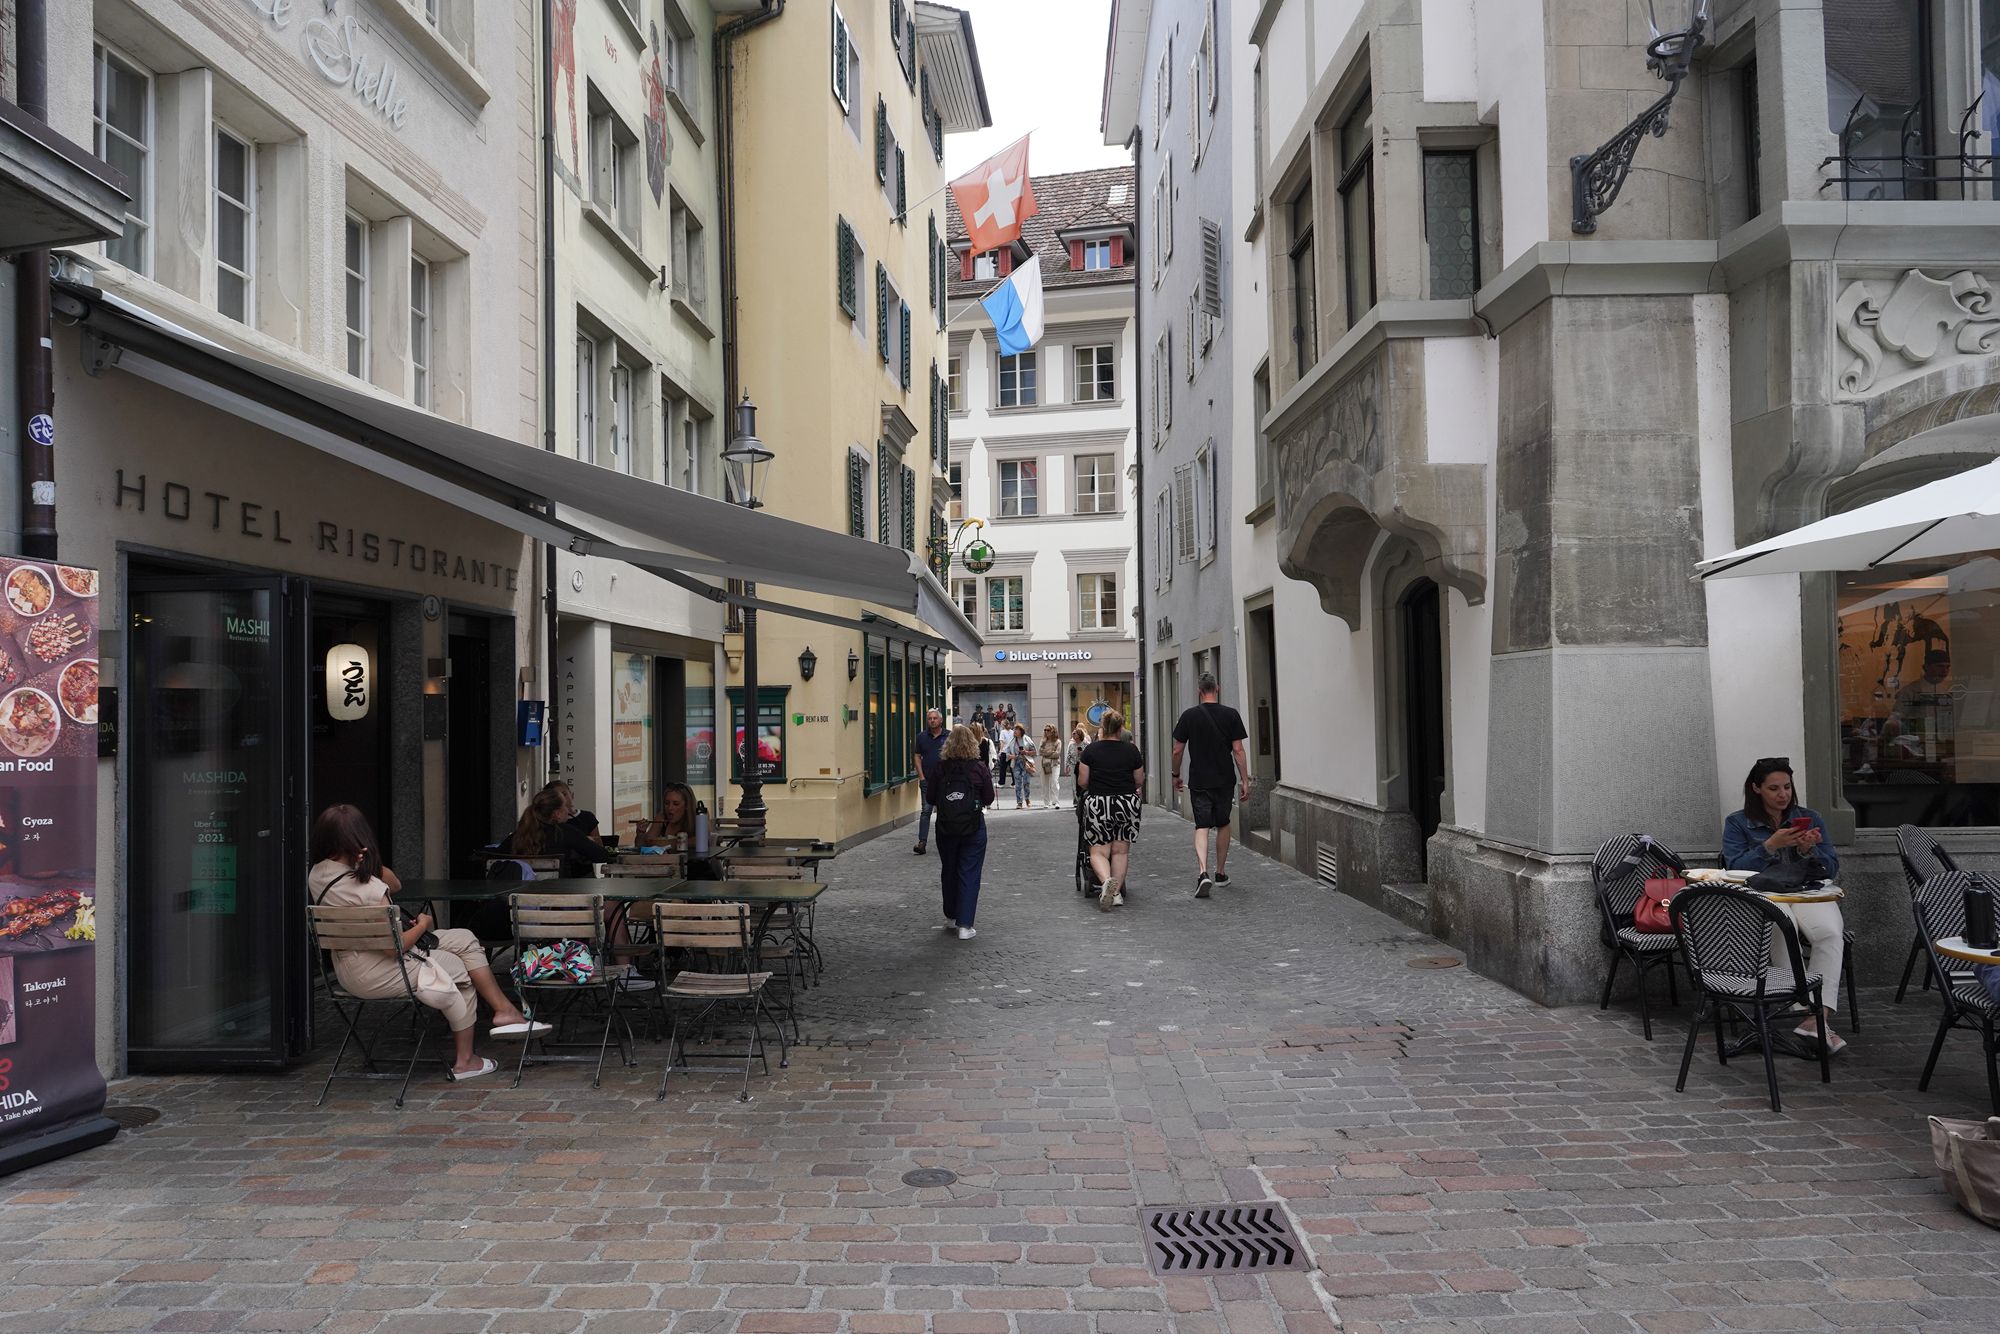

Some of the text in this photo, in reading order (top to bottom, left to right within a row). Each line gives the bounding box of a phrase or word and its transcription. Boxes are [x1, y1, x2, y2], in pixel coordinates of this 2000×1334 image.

[305, 15, 408, 130] Stelle
[115, 468, 518, 592] HOTEL RISTORANTE
[226, 616, 270, 636] MASHI
[1009, 649, 1092, 661] blue-tomato
[341, 660, 366, 707] うどん
[805, 715, 816, 723] RENT
[566, 671, 575, 799] APPARTEME
[18, 758, 54, 772] Food
[183, 771, 247, 784] MASHIDA
[22, 816, 54, 829] Gyoza
[198, 833, 224, 843] 2021
[22, 977, 67, 993] Takoyaki
[4, 1112, 21, 1121] Take
[22, 1106, 42, 1116] Away
